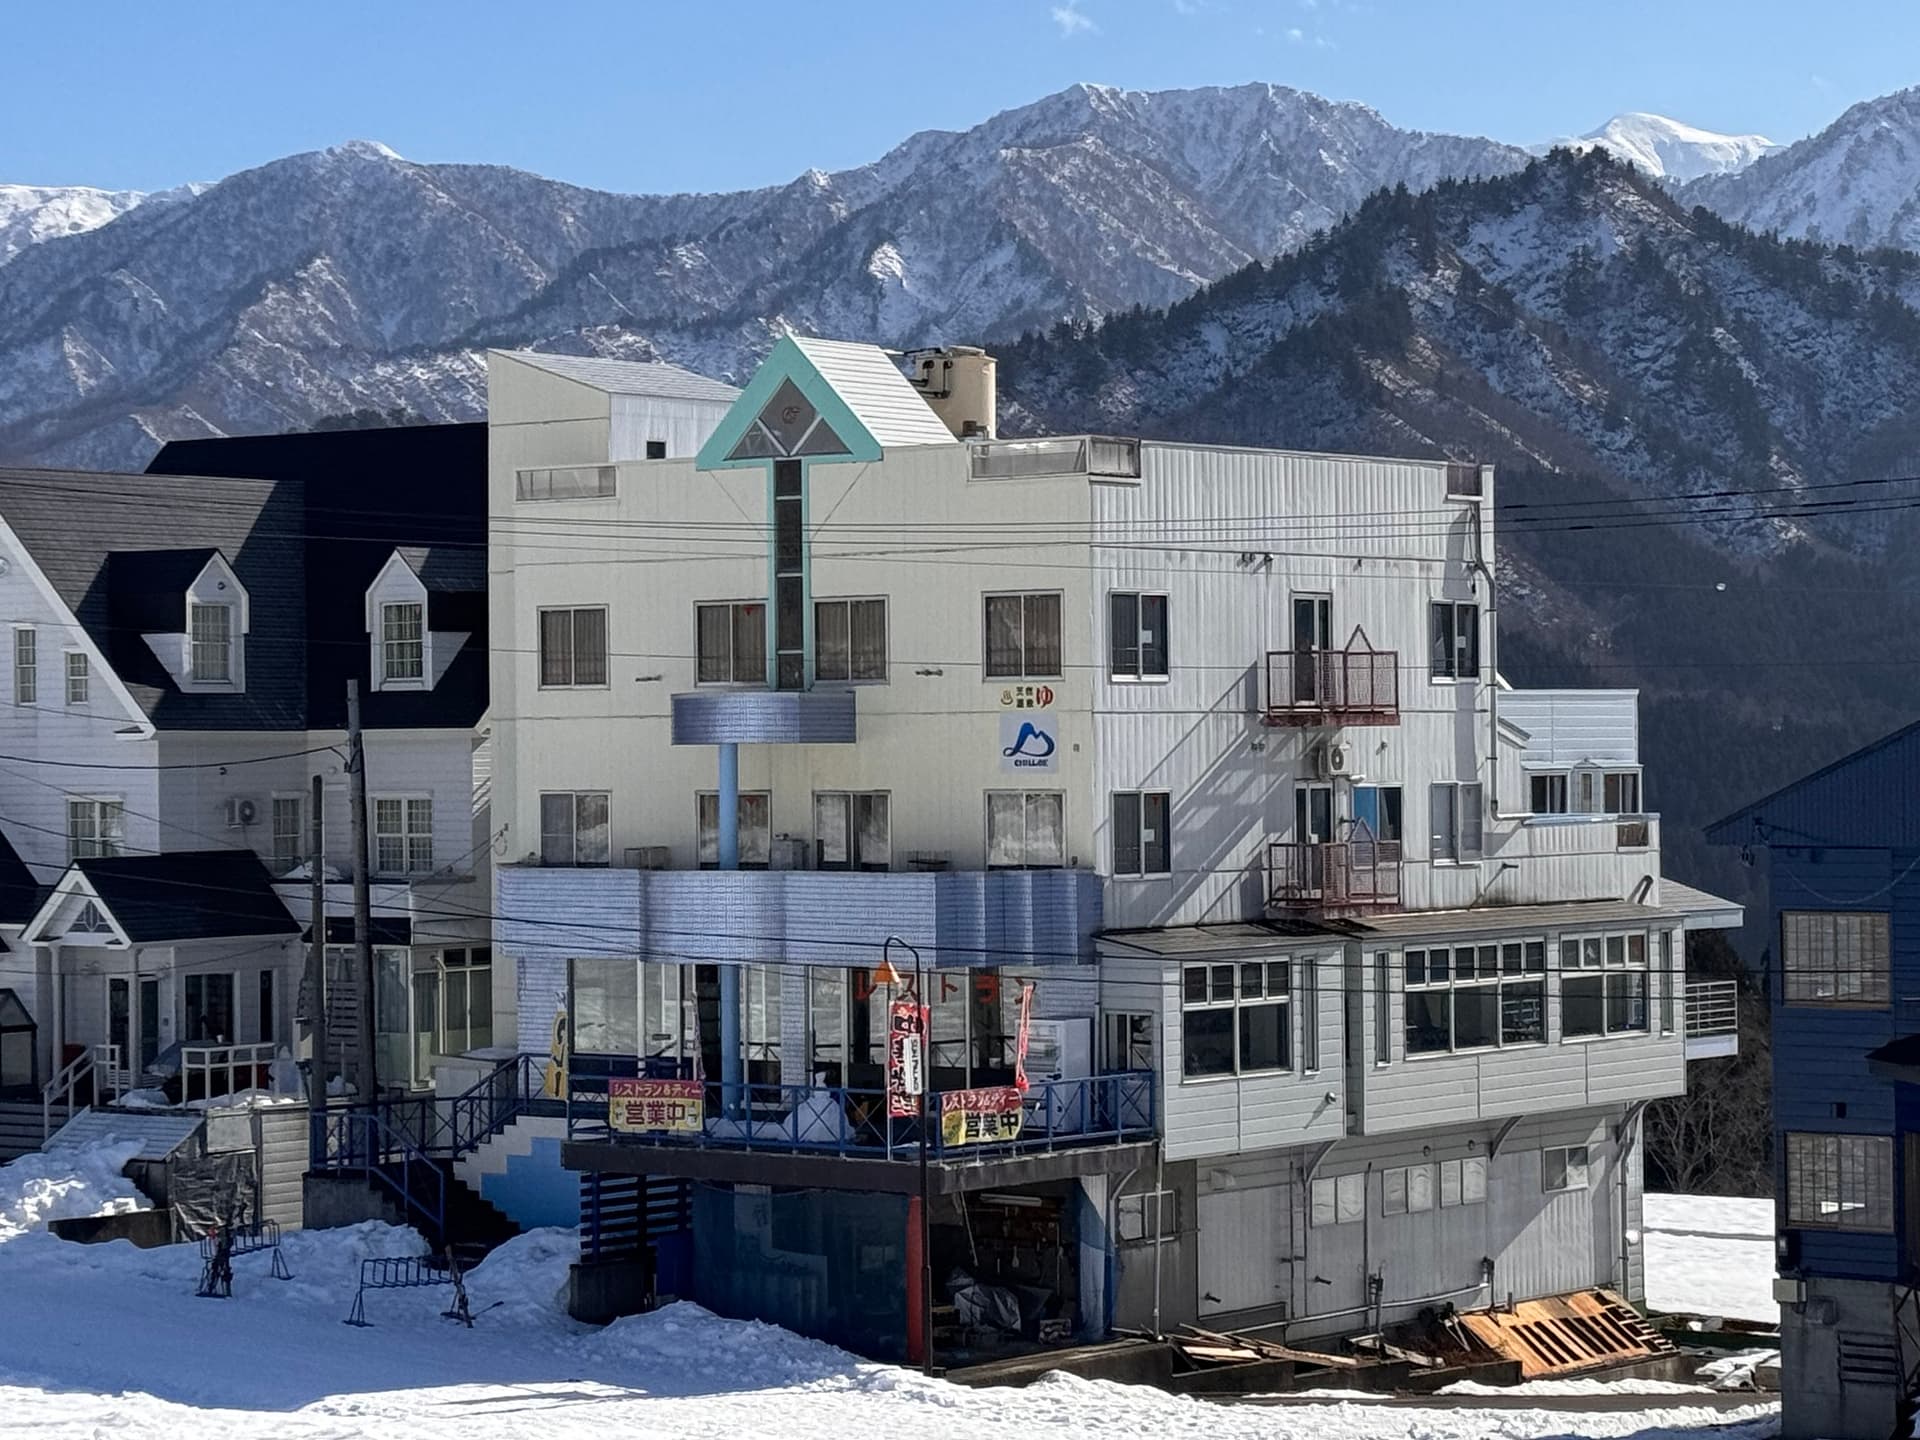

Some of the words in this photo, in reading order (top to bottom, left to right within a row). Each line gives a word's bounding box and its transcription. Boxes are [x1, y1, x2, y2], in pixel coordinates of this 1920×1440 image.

[1036, 685, 1054, 708] ゆ
[625, 1099, 686, 1126] 営業中
[965, 1109, 1019, 1138] 営業中
